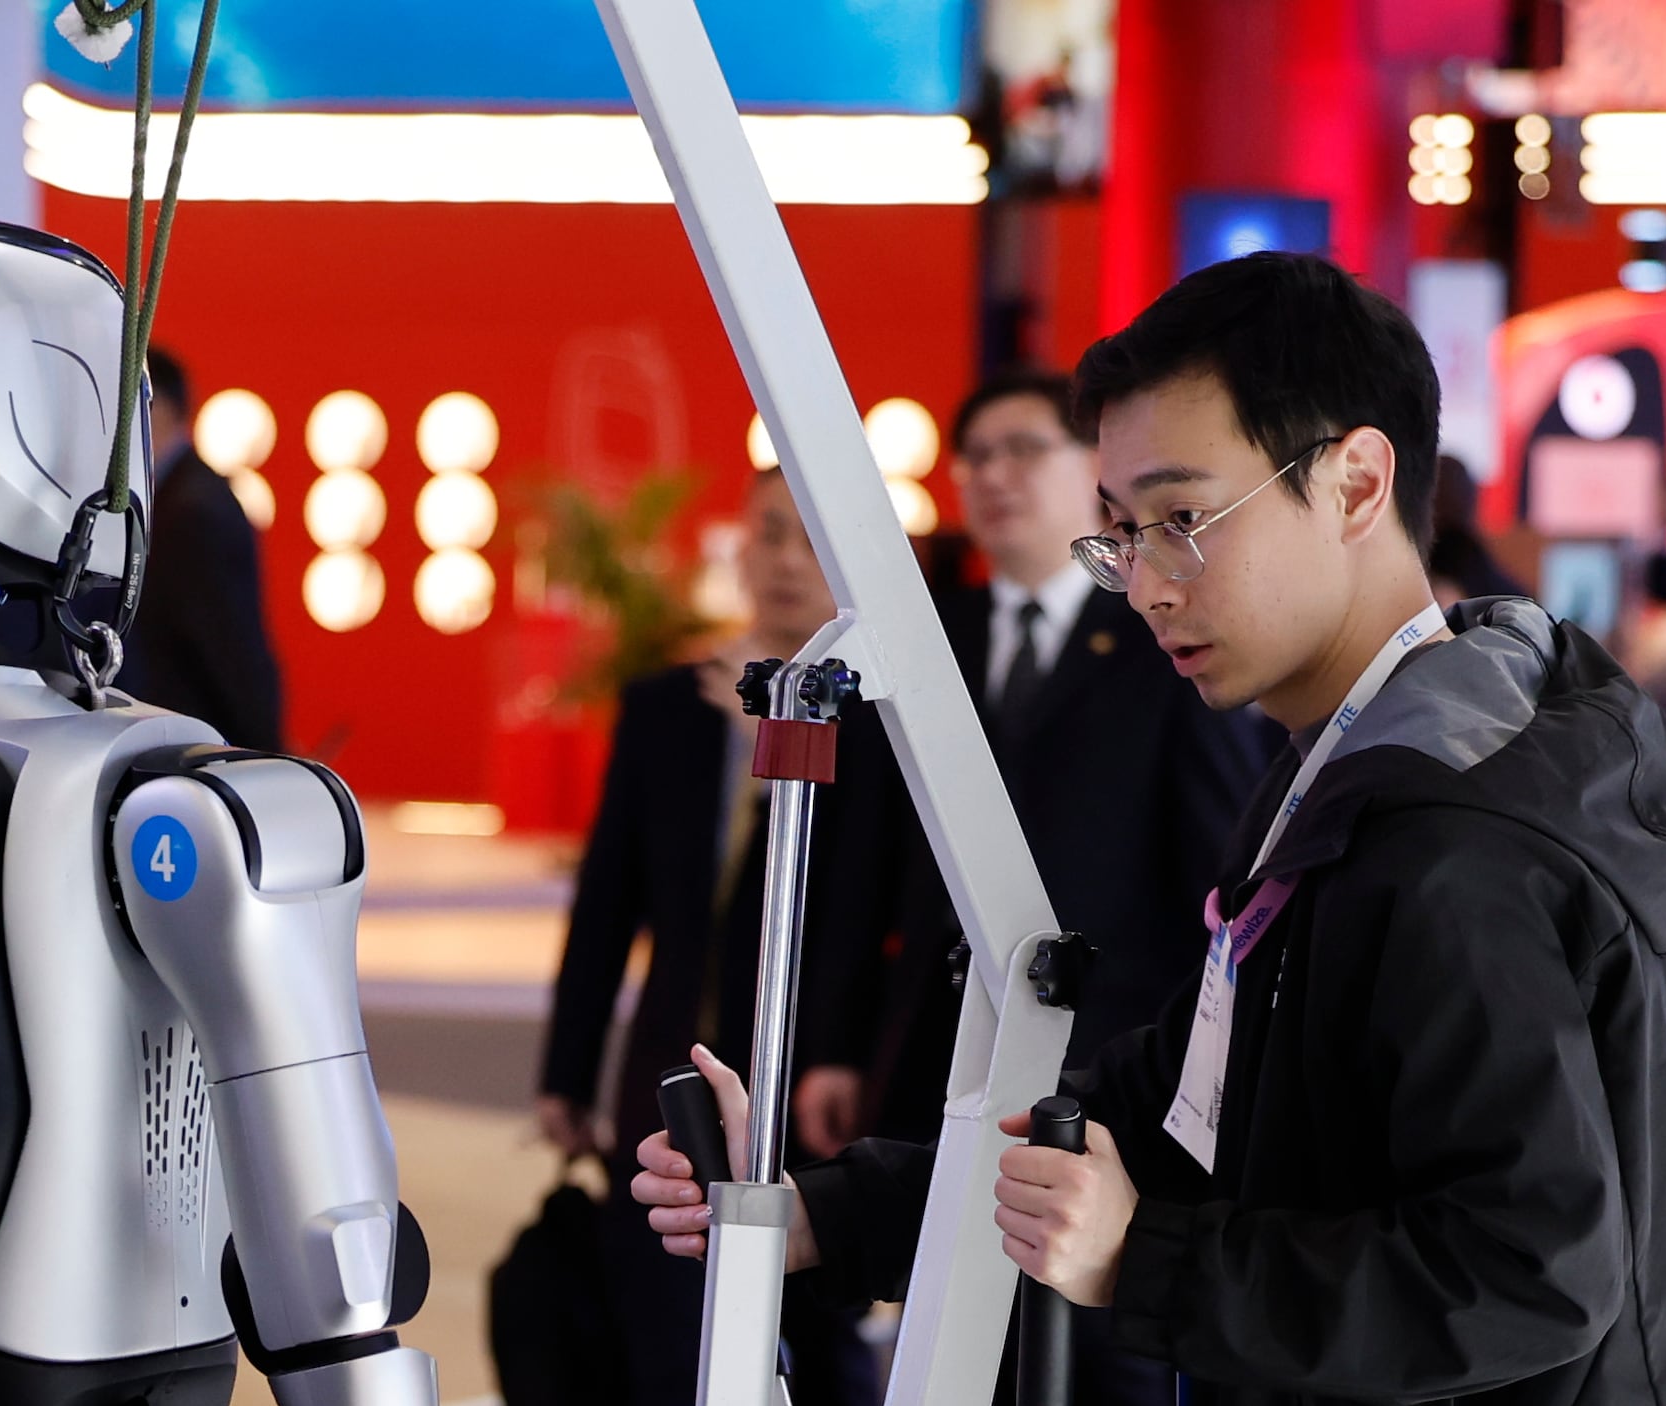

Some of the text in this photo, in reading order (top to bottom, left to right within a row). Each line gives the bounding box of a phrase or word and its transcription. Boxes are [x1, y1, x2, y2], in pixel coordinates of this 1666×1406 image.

[1396, 624, 1423, 647] ZTE
[1334, 702, 1360, 733] ZTE
[1284, 792, 1303, 819] ZTE
[150, 834, 176, 882] 4
